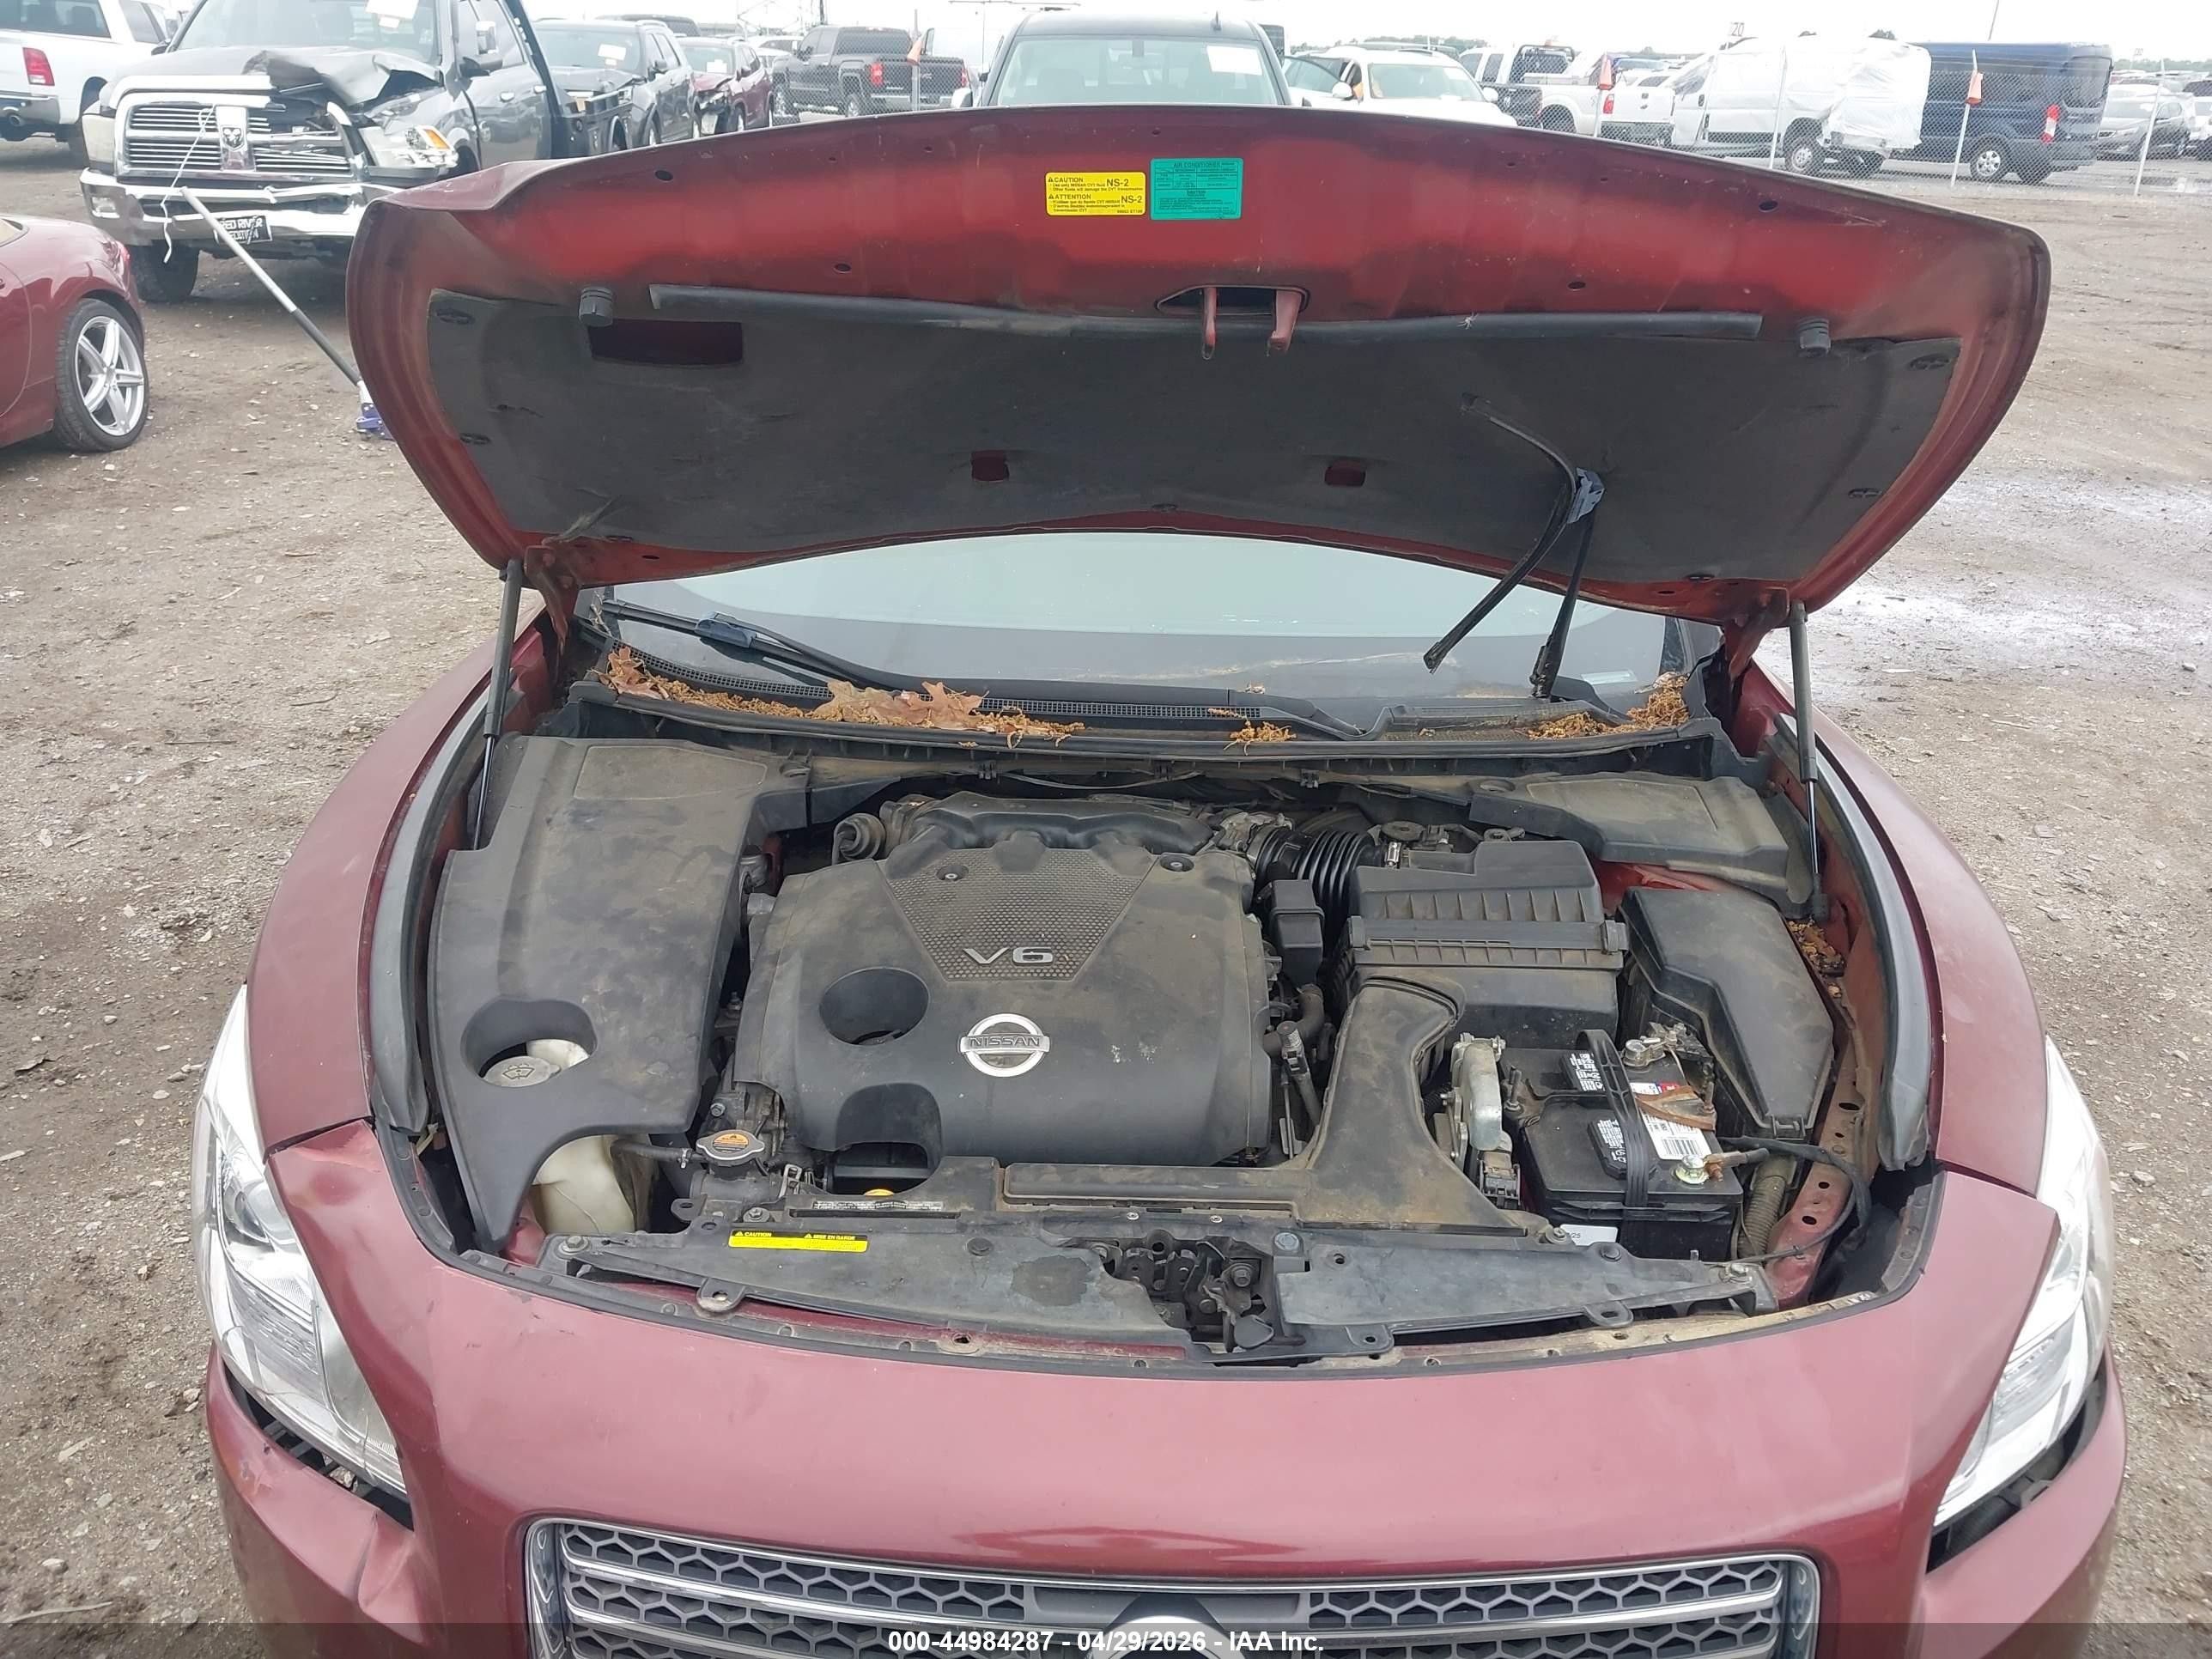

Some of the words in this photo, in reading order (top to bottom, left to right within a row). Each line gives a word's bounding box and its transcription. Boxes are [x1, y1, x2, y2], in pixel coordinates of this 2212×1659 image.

[1106, 178, 1129, 187] NS-2
[1121, 195, 1143, 204] NS-2
[963, 946, 1054, 967] V6
[969, 1036, 1042, 1048] NISSAN
